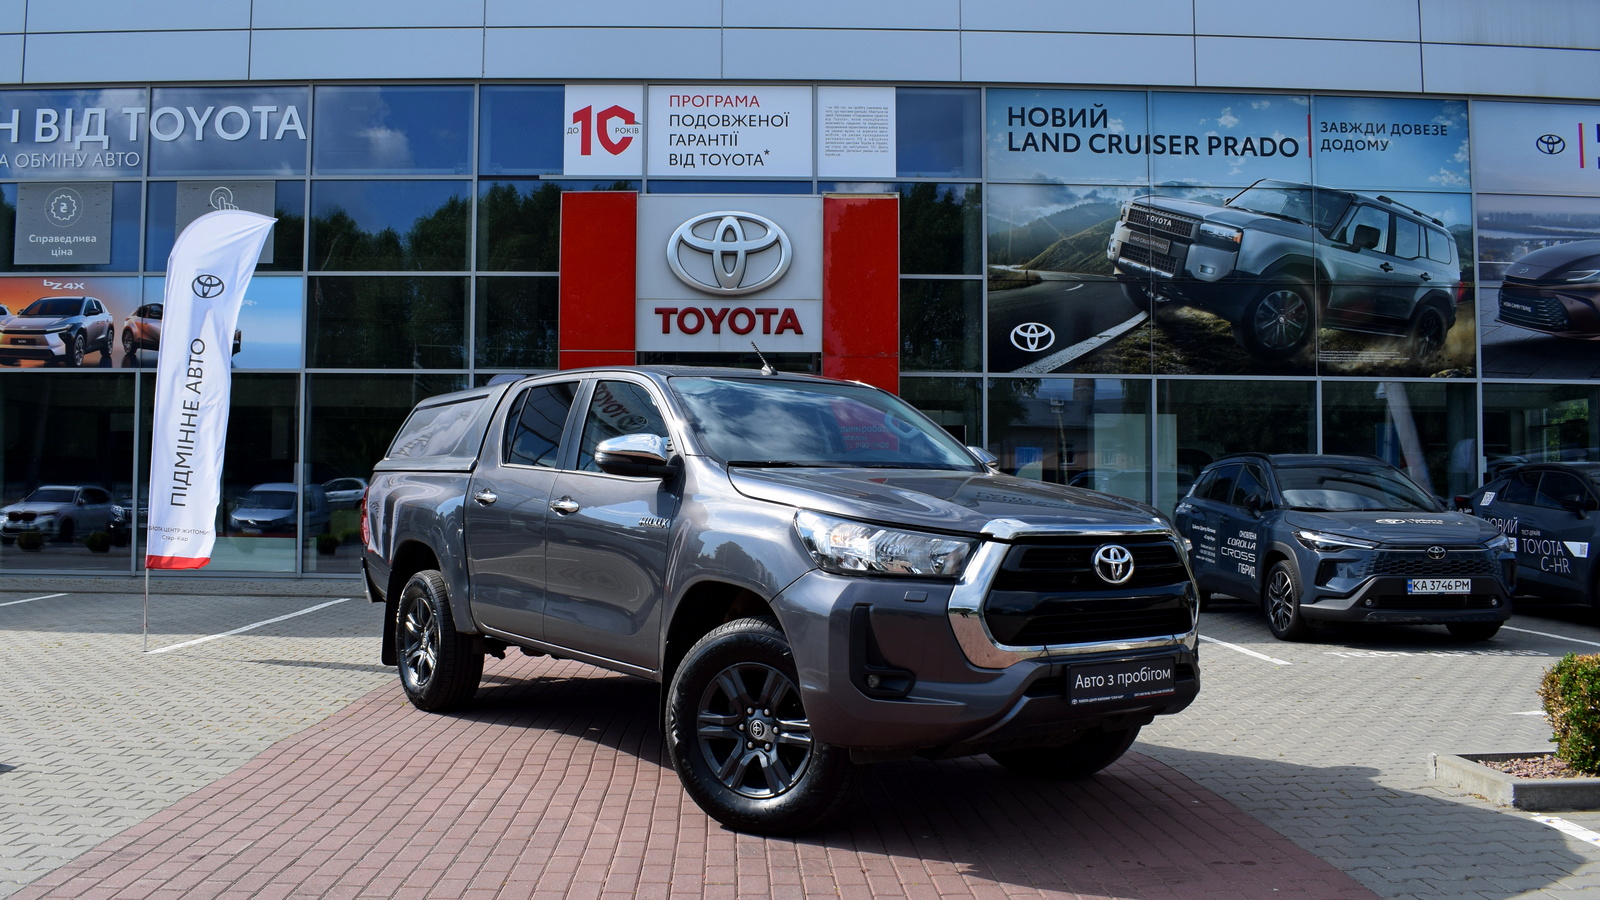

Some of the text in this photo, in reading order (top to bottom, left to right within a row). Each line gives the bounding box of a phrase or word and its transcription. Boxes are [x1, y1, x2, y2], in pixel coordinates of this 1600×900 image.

[669, 95, 760, 107] ПРОГРАМА
[669, 111, 790, 129] ПОДОВЖЕНОЇ
[1007, 103, 1108, 128] НОВИЙ
[35, 108, 109, 150] ВІД
[122, 106, 307, 142] TOYOTA
[1320, 122, 1448, 136] ЗАВЖДИ ДОВЕЗЕ
[669, 131, 739, 146] ГАРАНТІЇ
[1007, 132, 1299, 158] LAND CRUISER PRADO
[1320, 138, 1389, 152] ДОДОМУ
[15, 153, 88, 168] ОБМІНУ
[92, 152, 140, 167] АВТО
[669, 153, 695, 168] ВІД
[1146, 215, 1172, 226] TOYOTA
[29, 235, 97, 244] Справедлива
[51, 247, 73, 257] ціна
[655, 307, 803, 335] TOYOTA
[170, 338, 206, 507] ПІДМІННЕ АВТО
[639, 516, 669, 528] HILUX
[1227, 537, 1257, 550] COROLLA
[1521, 538, 1564, 556] TOYOTA
[1221, 546, 1256, 563] CROSS
[1540, 556, 1571, 574] C-HR
[1429, 580, 1453, 591] 3746
[1074, 666, 1171, 689] Авто з пробігом
